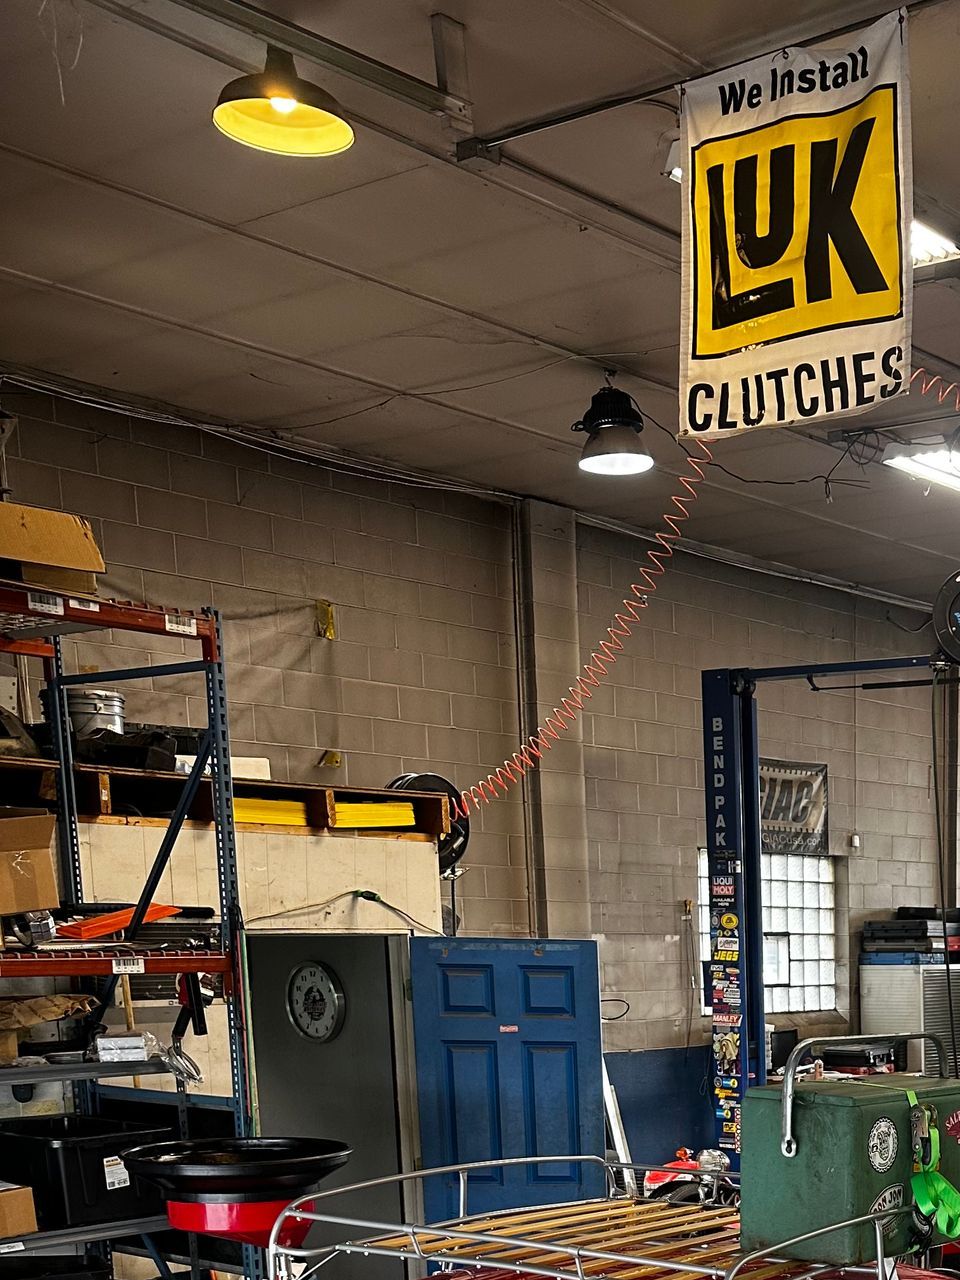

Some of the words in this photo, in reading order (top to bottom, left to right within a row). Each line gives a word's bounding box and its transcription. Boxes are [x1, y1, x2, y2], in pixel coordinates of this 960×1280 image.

[718, 80, 762, 116] We
[770, 45, 869, 102] Install
[687, 346, 903, 431] CLUTCHES
[713, 877, 733, 885] LIQUI
[713, 885, 734, 895] MOLY
[714, 951, 739, 960] JEGS
[713, 1014, 738, 1022] MANLEY
[889, 1188, 902, 1204] JON
